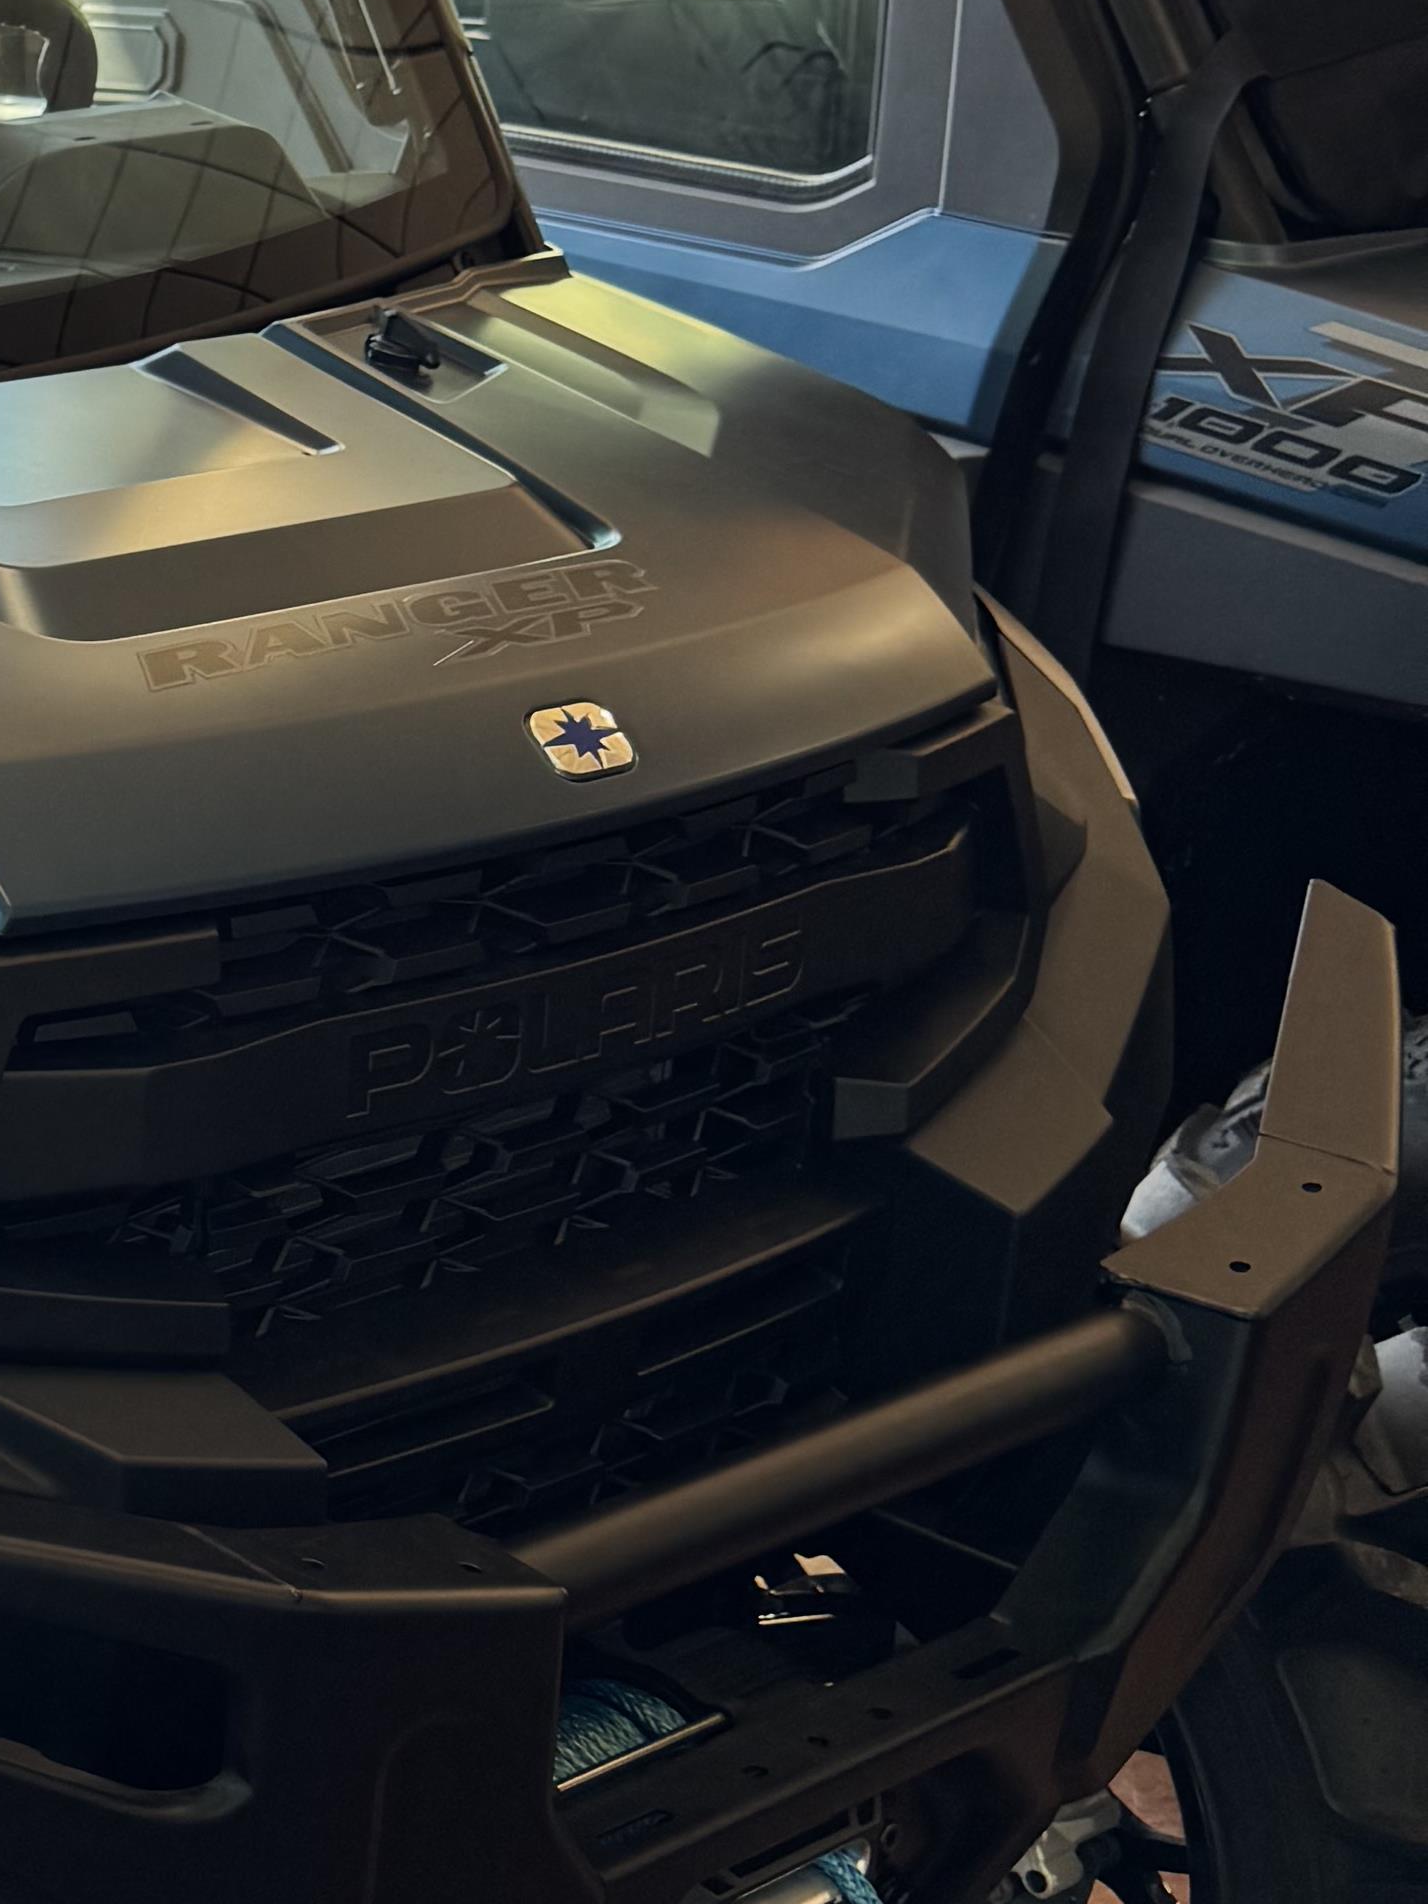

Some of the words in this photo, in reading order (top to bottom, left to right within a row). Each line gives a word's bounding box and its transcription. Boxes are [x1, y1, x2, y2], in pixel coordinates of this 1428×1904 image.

[1148, 396, 1423, 496] 1000
[139, 560, 659, 691] RANGER
[434, 599, 645, 667] XP
[344, 912, 804, 1120] POLARIS
